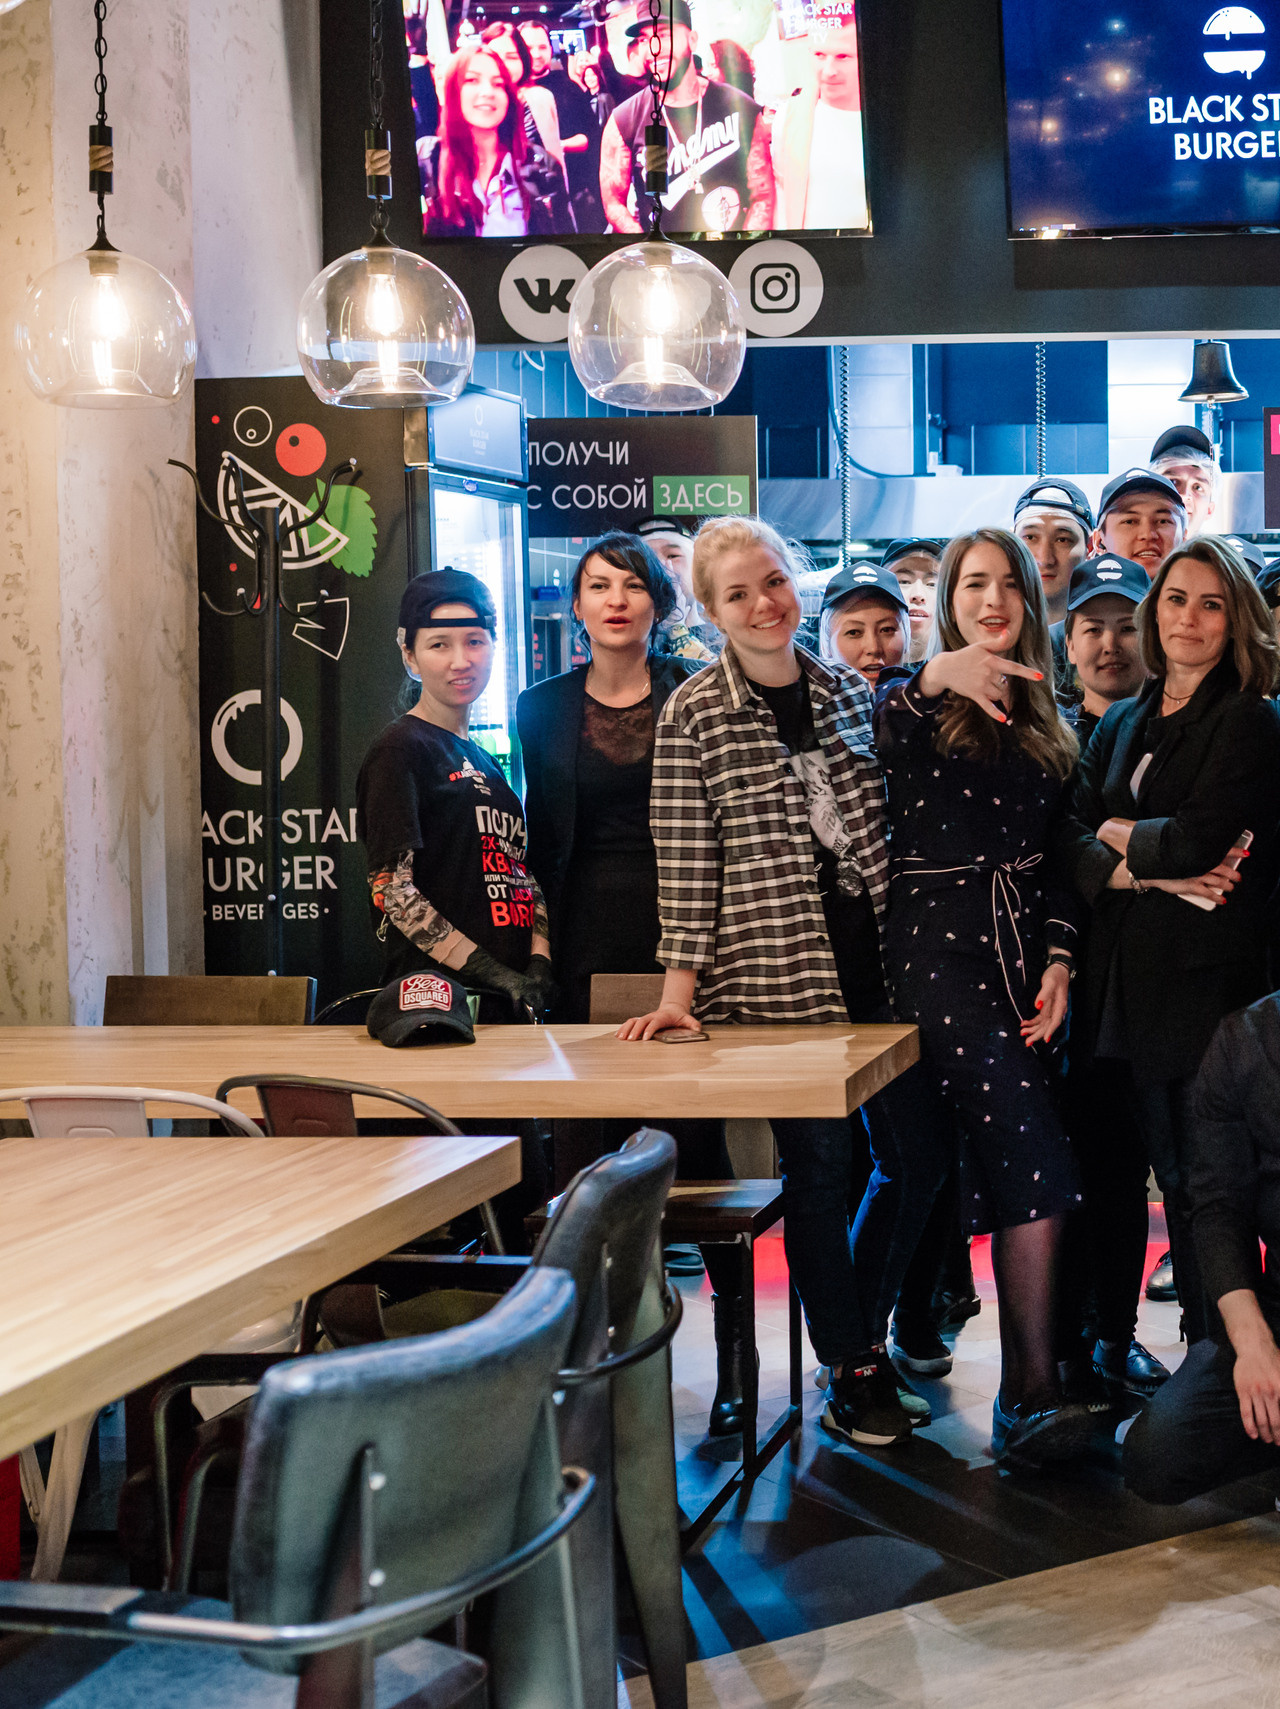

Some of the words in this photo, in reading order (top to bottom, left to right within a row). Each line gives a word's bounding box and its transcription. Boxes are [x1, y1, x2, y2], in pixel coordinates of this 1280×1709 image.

[1149, 94, 1245, 125] BLACK
[528, 441, 630, 466] ПОЛУЧИ
[527, 485, 542, 510] С
[552, 477, 647, 510] СОБОЙ
[660, 483, 743, 512] ЗДЕСЬ
[202, 809, 263, 846] ACK
[207, 855, 339, 893] URER
[211, 902, 320, 921] BEVEGES
[404, 990, 449, 1004] DSQUARED
[407, 976, 446, 992] Best
